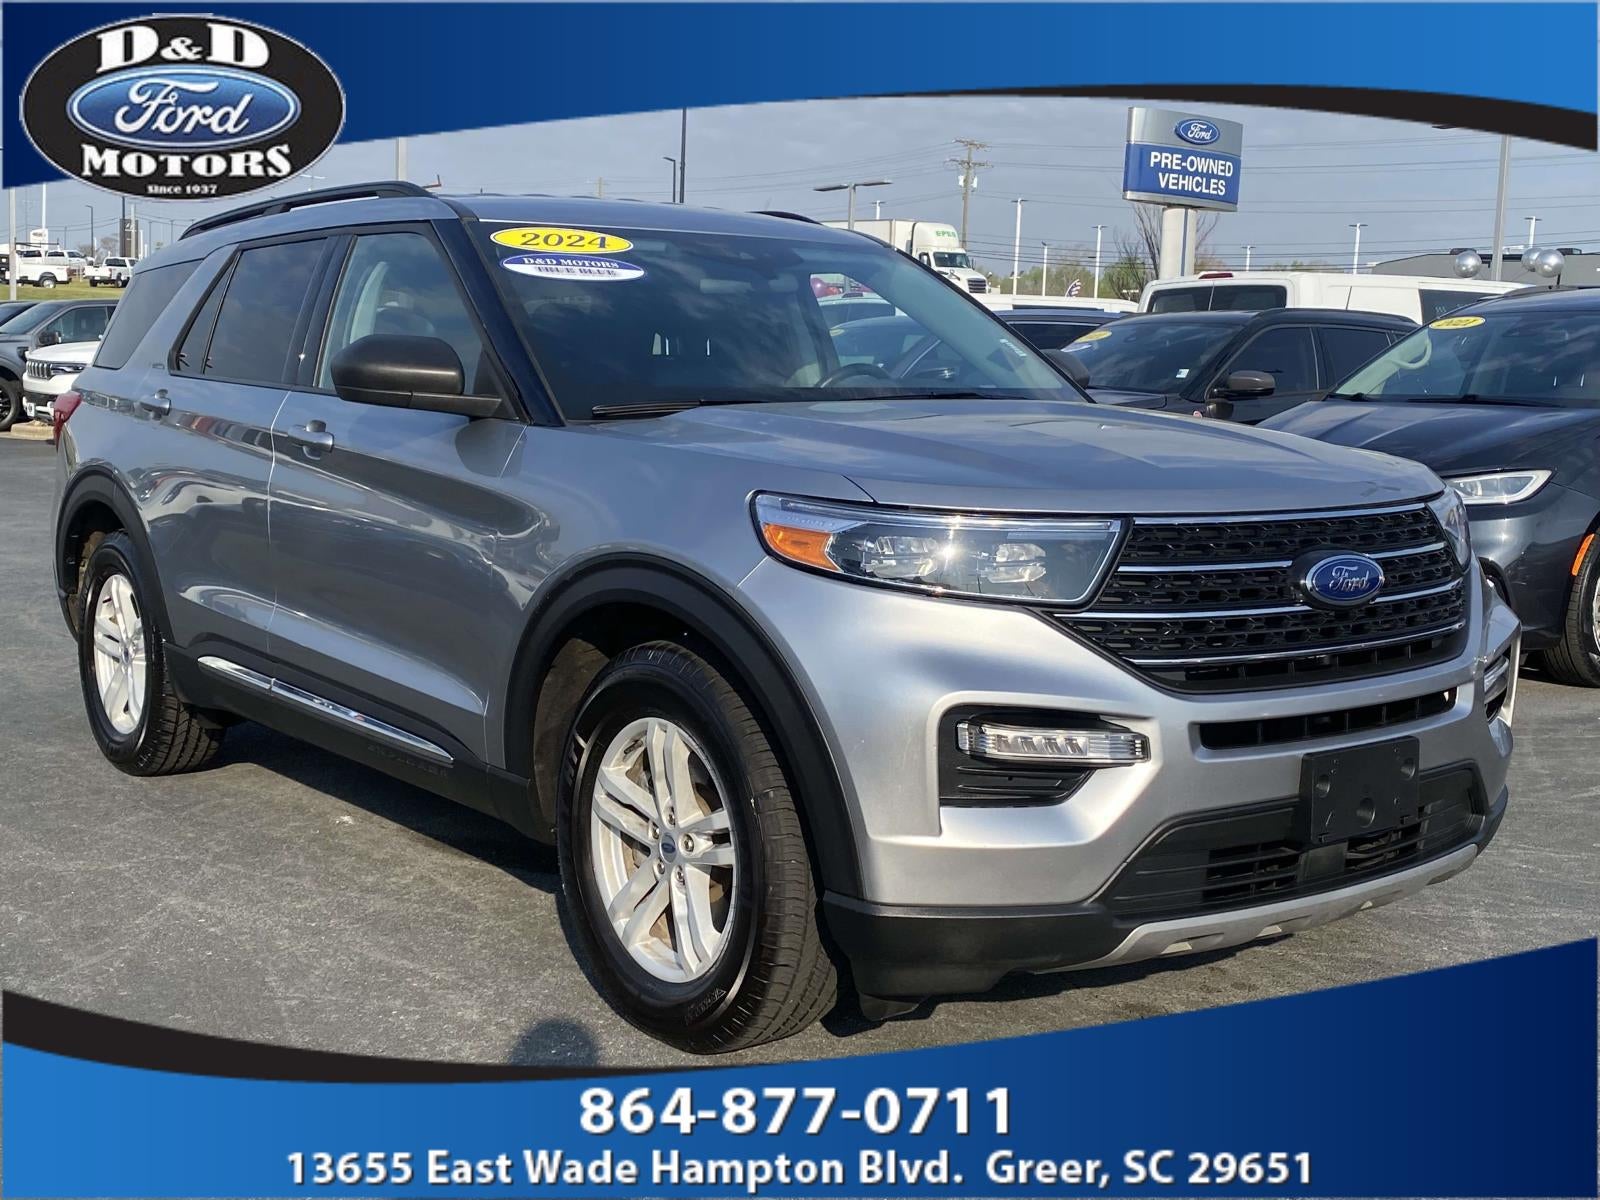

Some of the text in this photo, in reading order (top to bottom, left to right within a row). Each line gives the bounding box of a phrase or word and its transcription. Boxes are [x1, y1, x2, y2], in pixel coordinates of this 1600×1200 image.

[1187, 123, 1212, 140] Ford
[1150, 151, 1234, 177] PRE-OWNED
[1158, 172, 1226, 196] VEHICLES
[520, 232, 610, 249] 2024
[522, 257, 620, 269] D&D MOTORS
[1329, 565, 1370, 591] Ford
